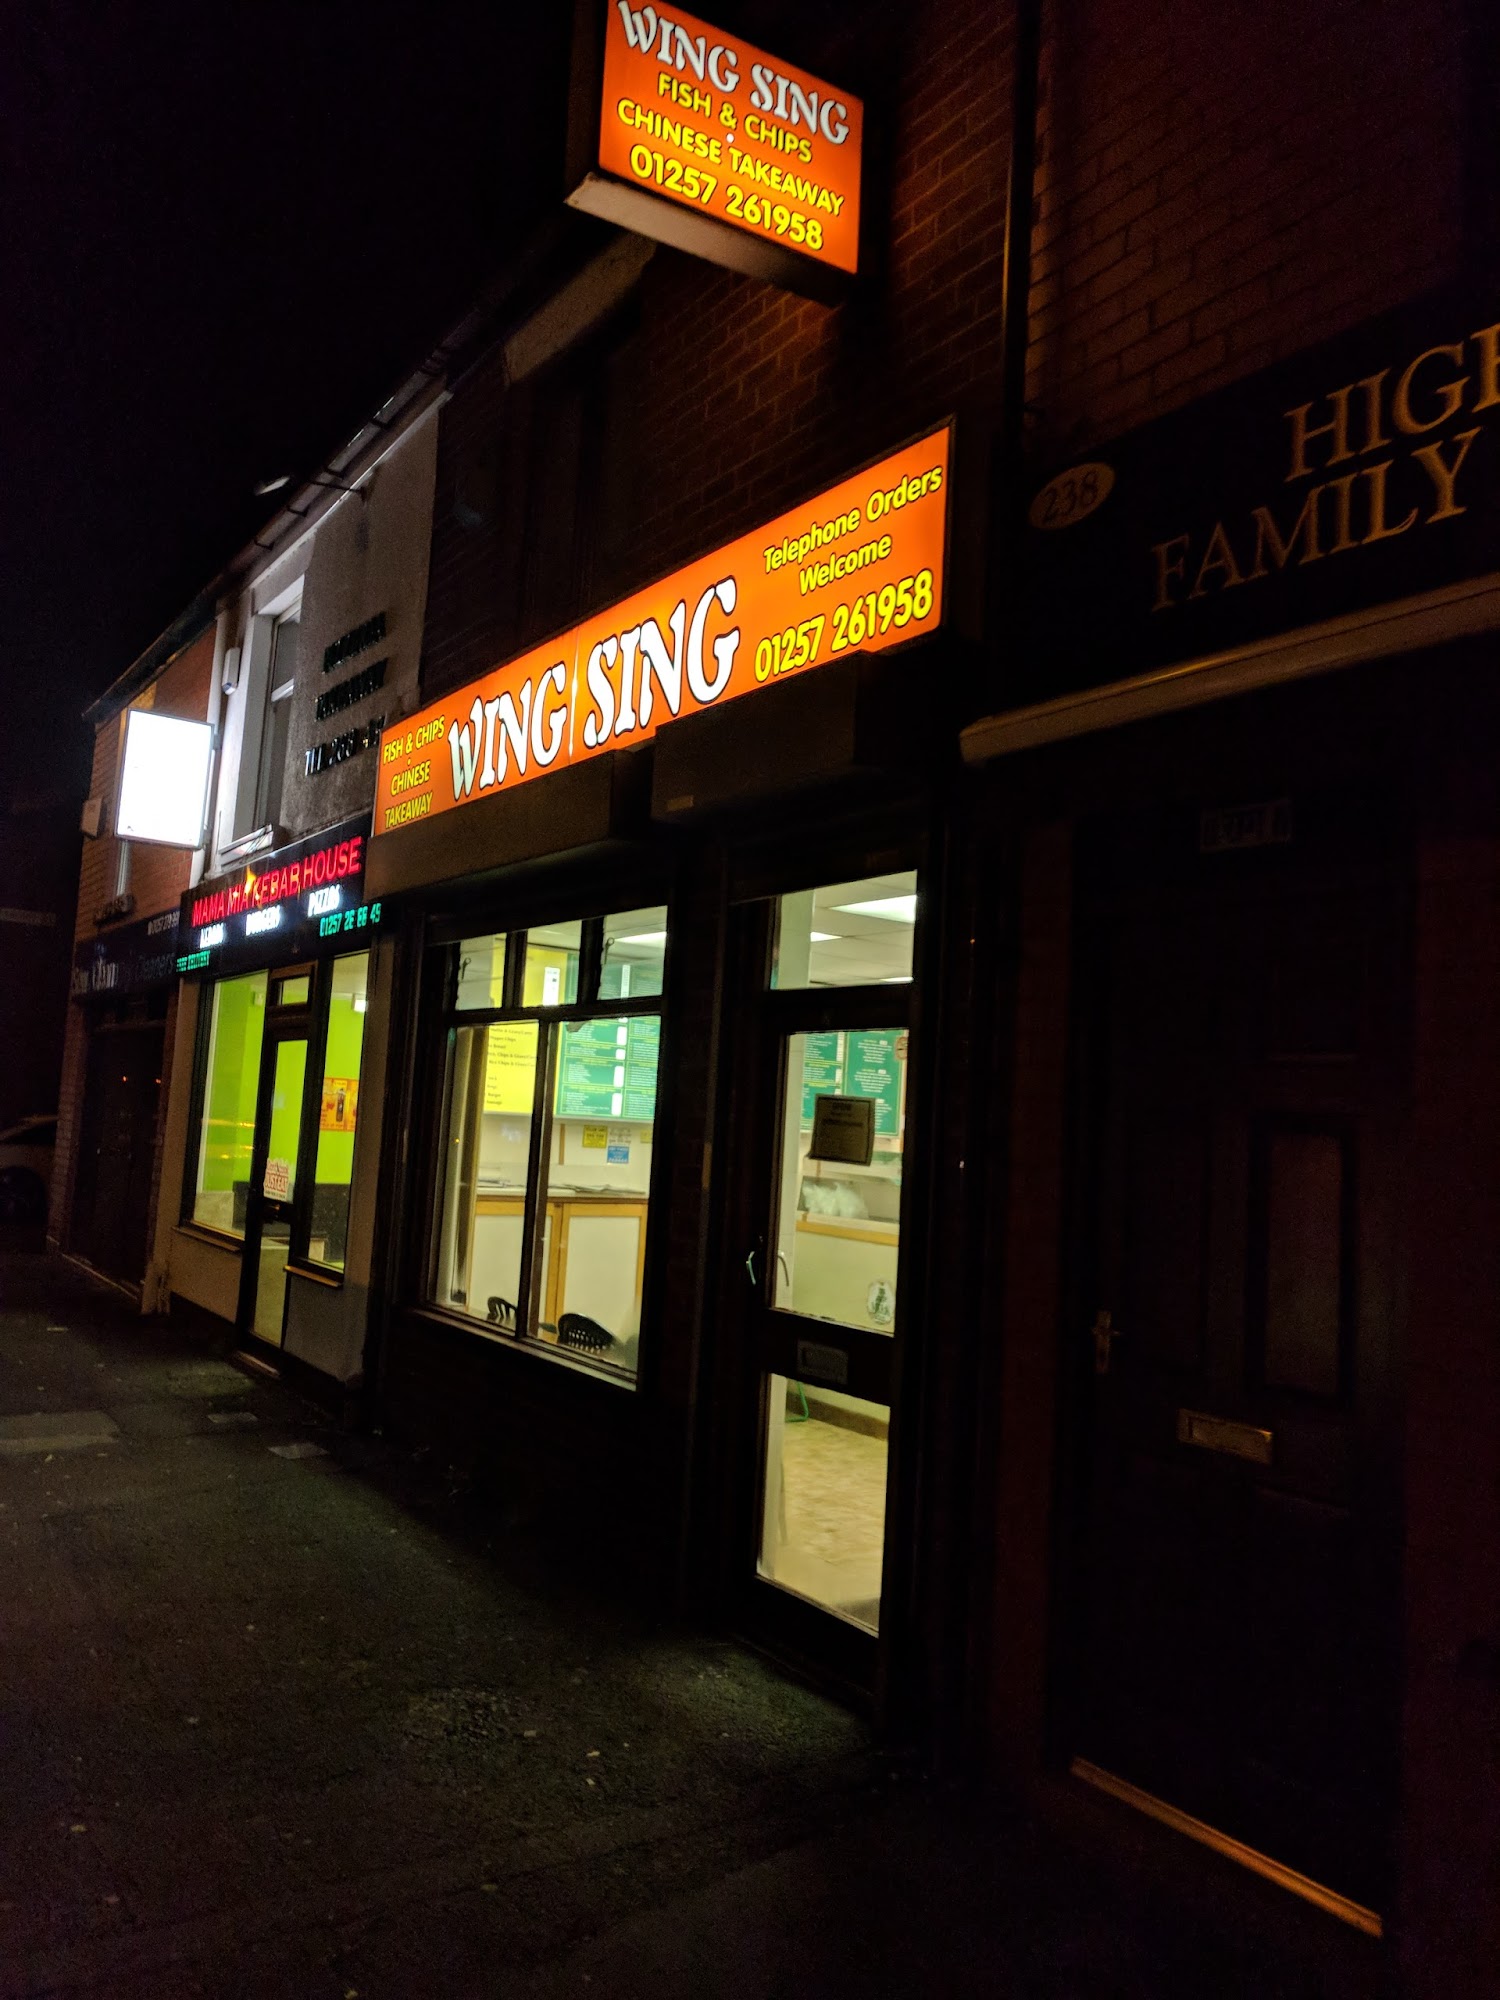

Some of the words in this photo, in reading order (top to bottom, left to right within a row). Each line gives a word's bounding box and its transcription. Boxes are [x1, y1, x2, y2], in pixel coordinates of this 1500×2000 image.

[616, 0, 739, 93] WING
[750, 64, 849, 145] SING
[658, 72, 712, 118] FISH
[719, 103, 737, 130] &
[744, 114, 812, 163] CHIPS
[617, 98, 722, 164] CHINESE
[728, 147, 844, 217] TAKEAWAY
[630, 144, 717, 205] 01257
[725, 184, 824, 251] 261958
[763, 507, 861, 574] Telephone
[866, 466, 943, 522] Orders
[1041, 470, 1099, 524] 238
[1151, 425, 1484, 613] FAMILY
[800, 534, 893, 596] Welcome
[754, 613, 826, 683] 01257
[831, 568, 933, 652] 261958
[447, 662, 568, 801] WING
[583, 575, 741, 749] SING
[383, 740, 403, 766] FISH
[405, 735, 413, 754] &
[415, 715, 446, 745] CHIPS
[390, 760, 431, 797] CHINESE
[384, 791, 433, 829] TAKEAWAY
[192, 889, 225, 929] MAMA
[227, 882, 250, 917] MIA
[252, 862, 300, 908] KEBAB
[302, 836, 363, 891] HOUSE
